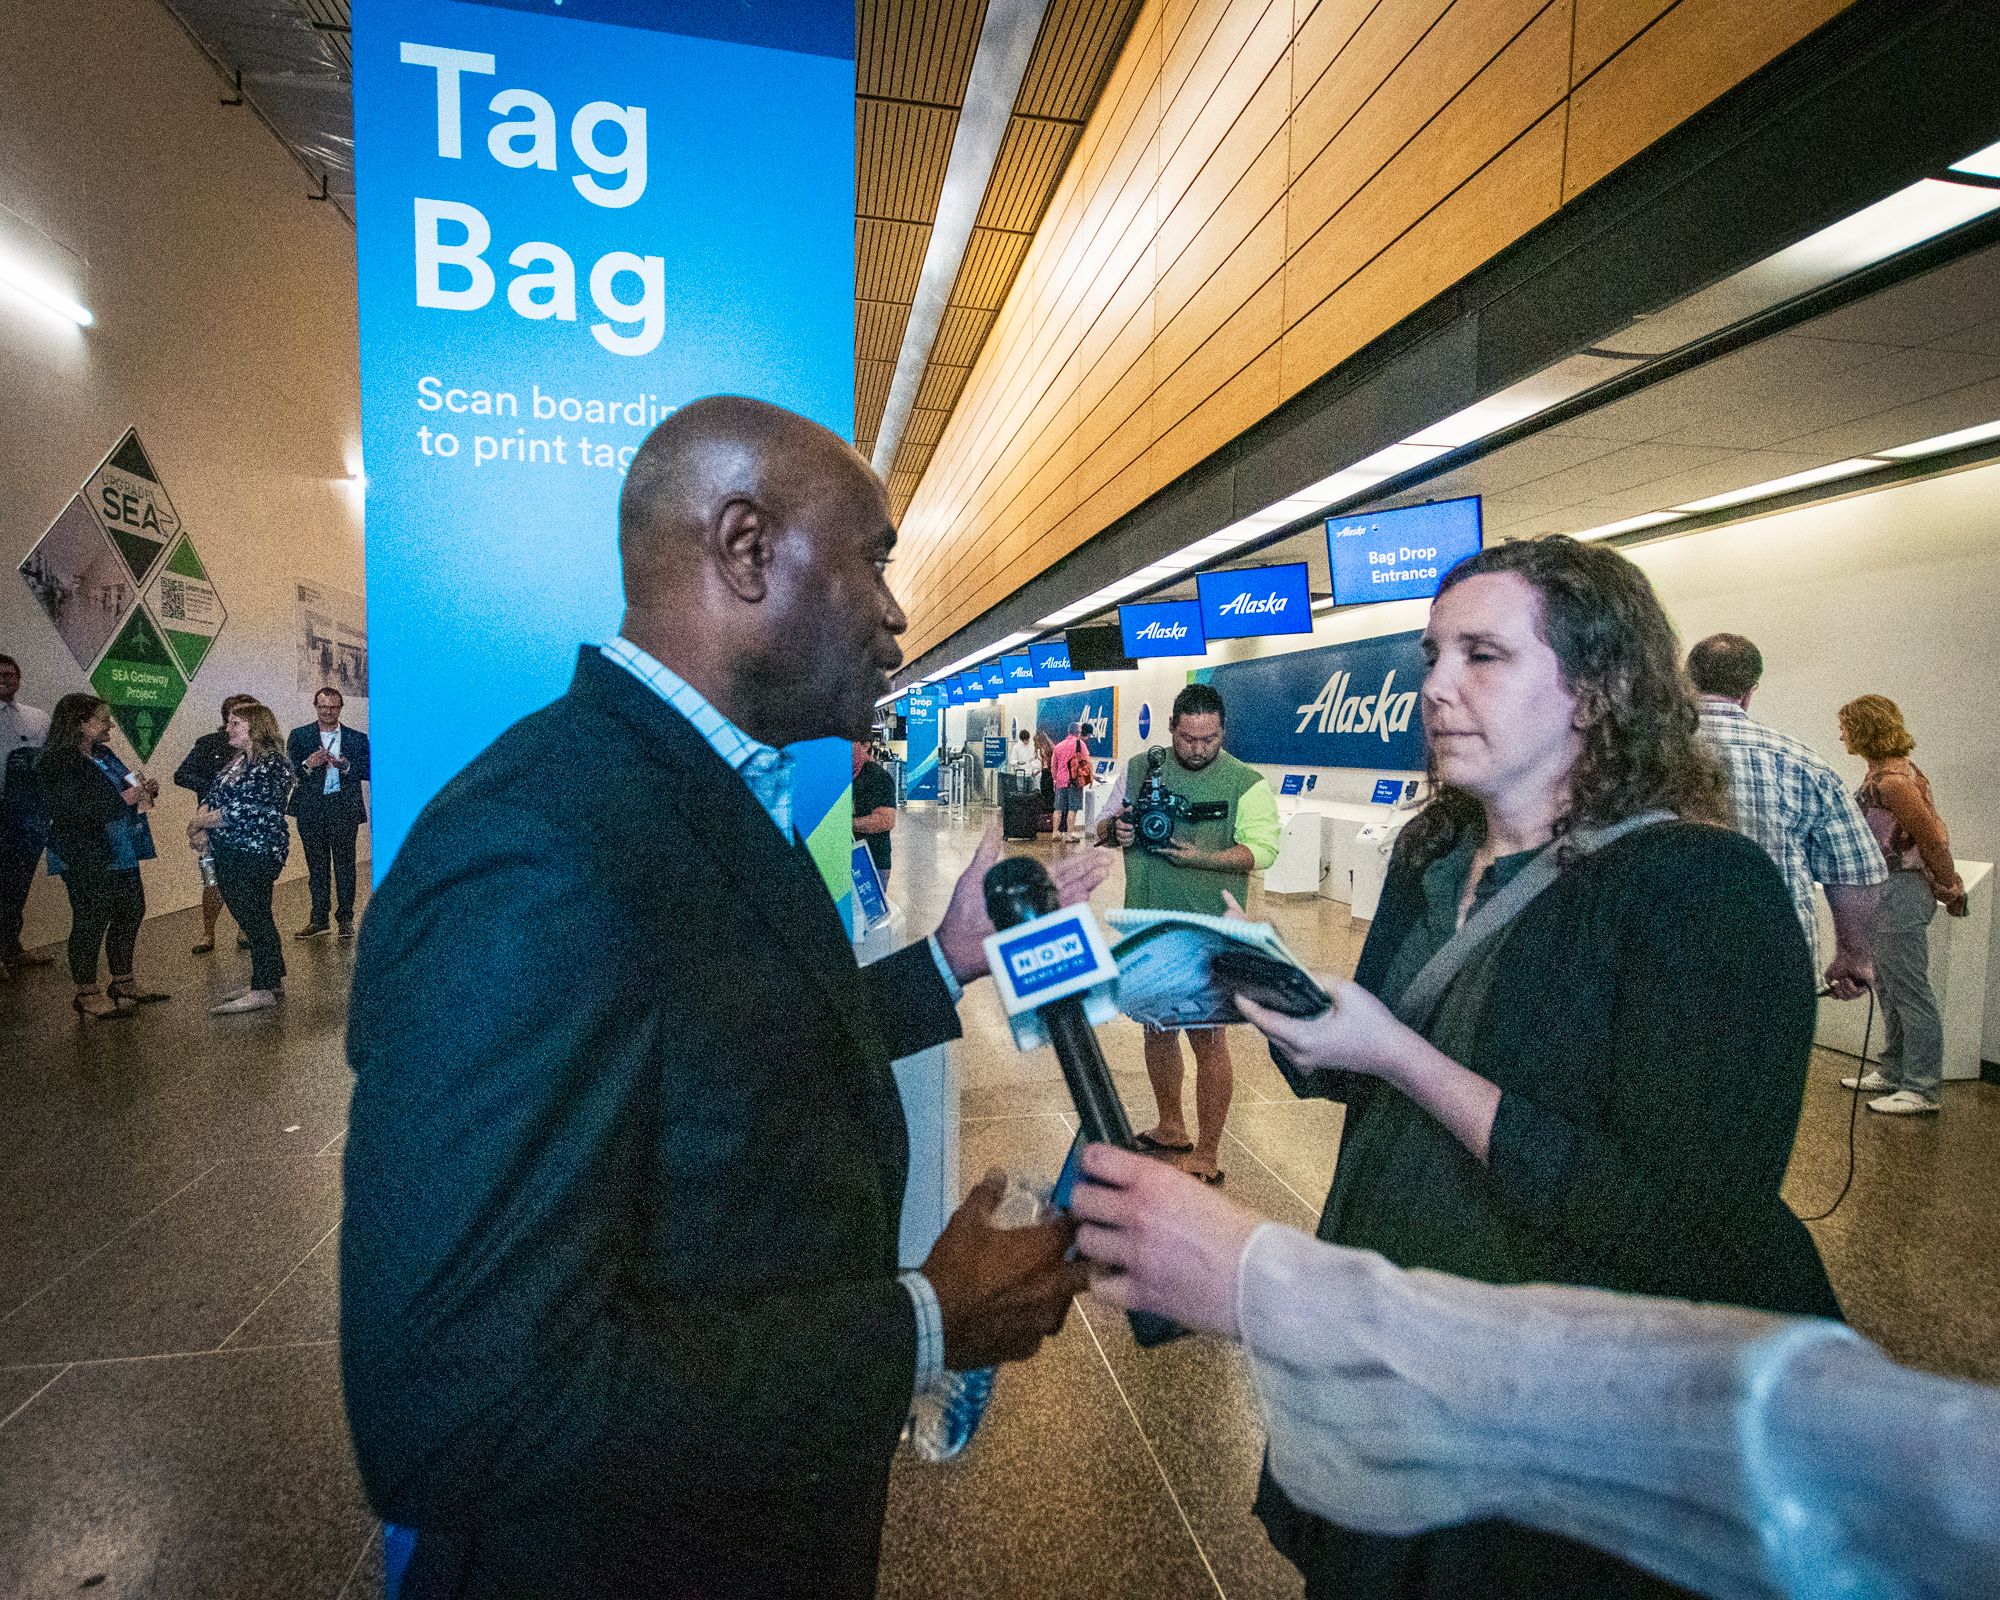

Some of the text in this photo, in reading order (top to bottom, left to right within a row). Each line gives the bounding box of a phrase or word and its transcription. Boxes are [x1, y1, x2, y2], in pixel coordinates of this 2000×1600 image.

[400, 41, 647, 209] Tag
[414, 197, 666, 357] Bag
[417, 376, 517, 417] Scan
[417, 425, 639, 476] to print tag
[102, 487, 161, 534] SEA
[1336, 525, 1367, 538] Alaska
[1369, 547, 1437, 565] Bag Drop
[1372, 567, 1438, 584] Entrance
[1219, 592, 1288, 615] Alaska
[1135, 622, 1188, 640] Alaska
[112, 669, 169, 688] SEA Gateway
[126, 686, 158, 704] Project
[910, 697, 932, 707] Drop
[1295, 669, 1418, 742] Alaska
[910, 707, 927, 717] Bag
[1016, 940, 1079, 971] NOW
